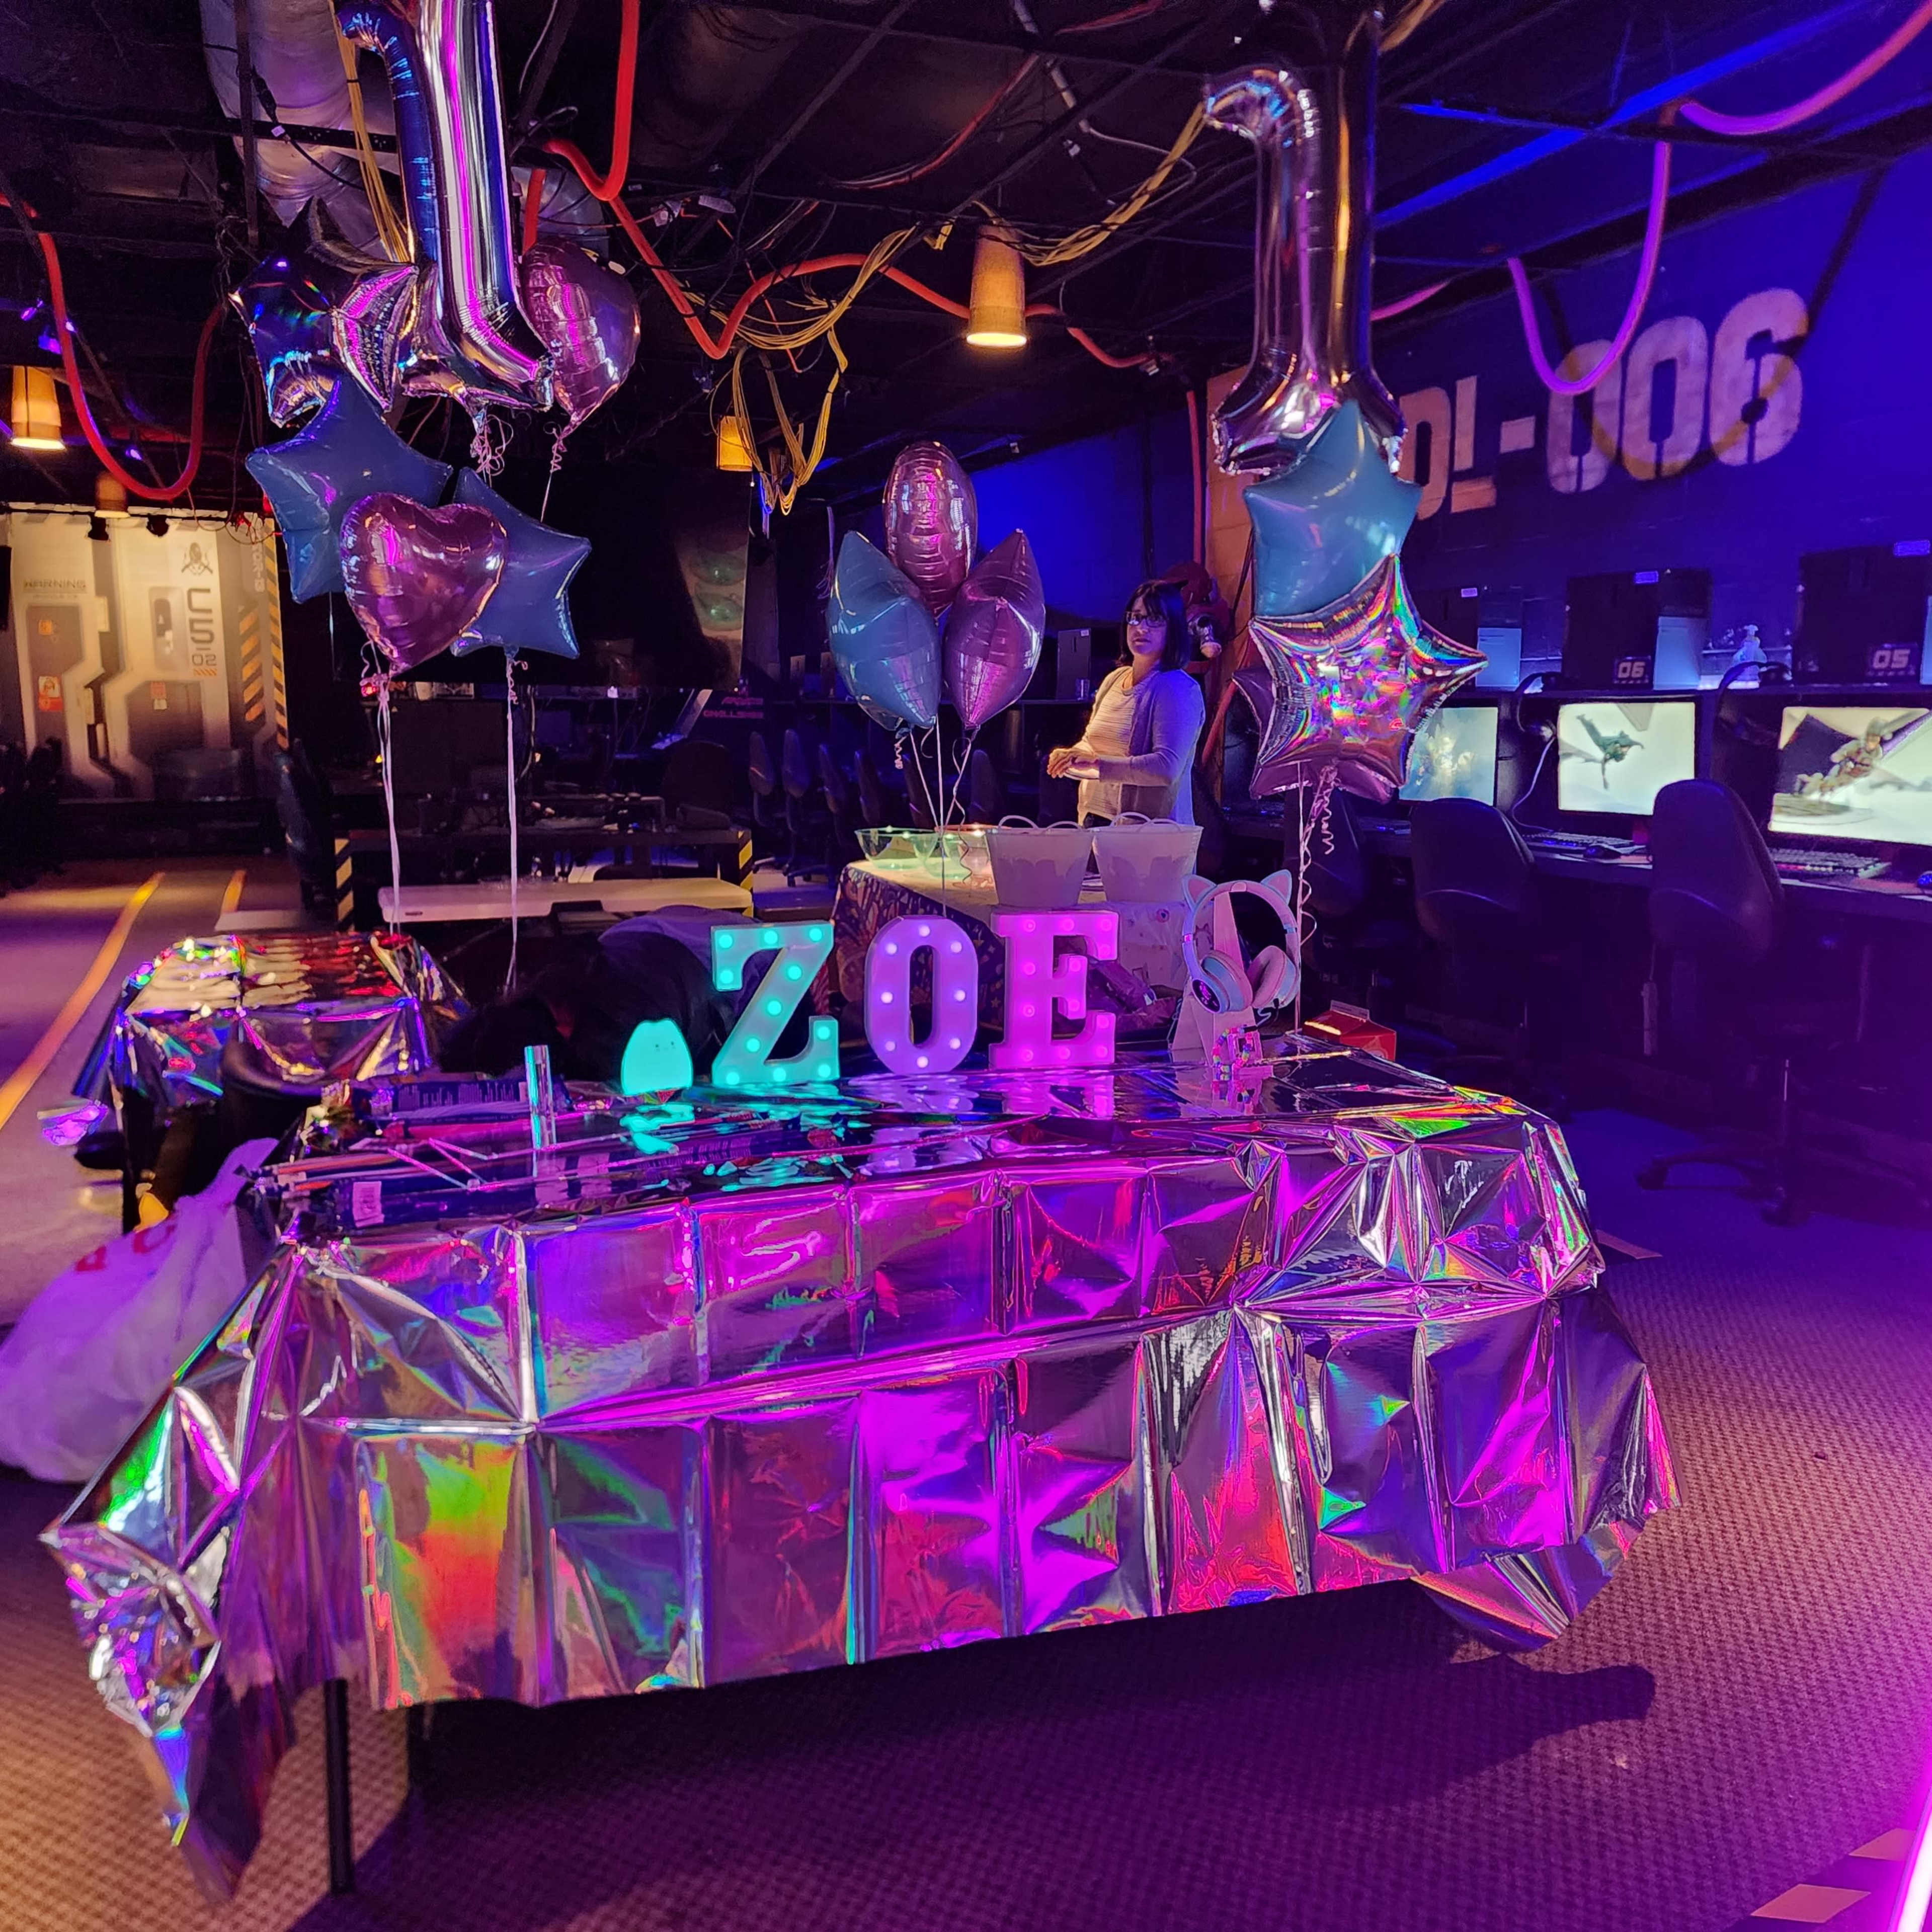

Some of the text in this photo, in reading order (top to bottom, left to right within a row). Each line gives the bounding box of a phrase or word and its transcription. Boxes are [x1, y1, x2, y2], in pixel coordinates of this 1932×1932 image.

[1873, 649, 1911, 669] 05
[1618, 661, 1645, 679] 06
[710, 910, 1119, 1087] ZOE
